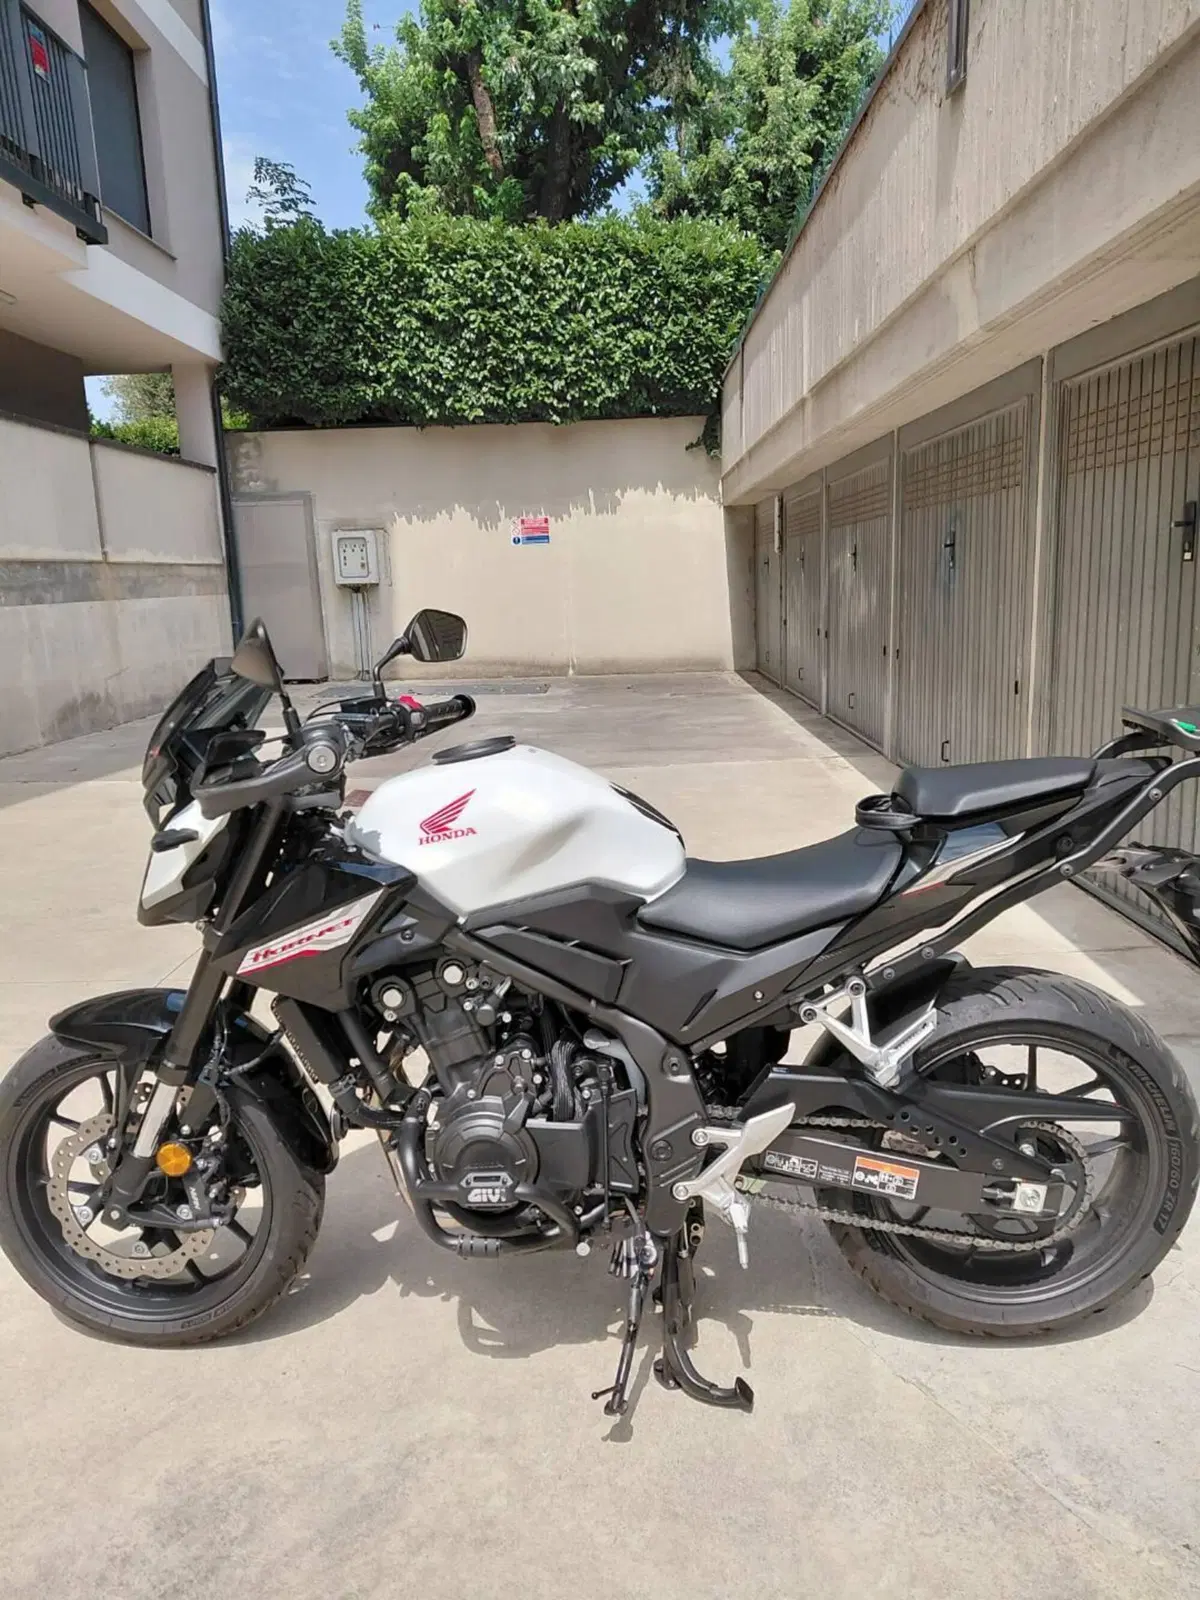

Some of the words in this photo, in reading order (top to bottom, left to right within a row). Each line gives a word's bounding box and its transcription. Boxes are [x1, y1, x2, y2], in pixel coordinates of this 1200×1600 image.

[418, 827, 477, 845] HONDA
[1127, 1063, 1177, 1132] MICHELIN
[1167, 1141, 1182, 1189] 160/60
